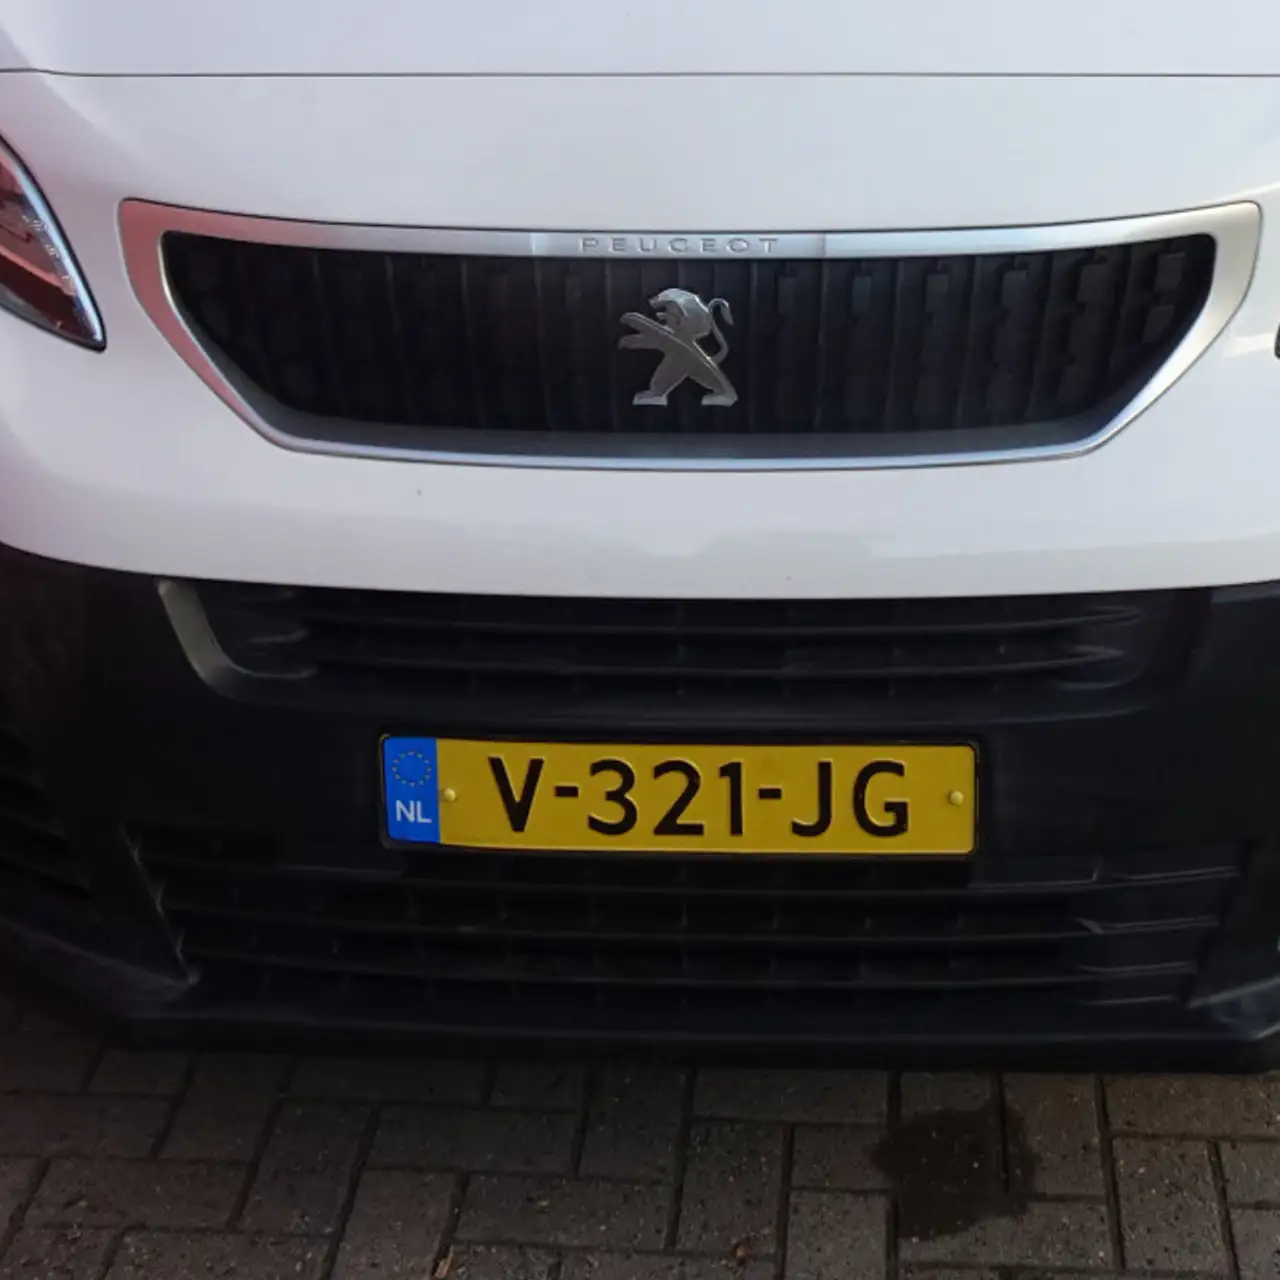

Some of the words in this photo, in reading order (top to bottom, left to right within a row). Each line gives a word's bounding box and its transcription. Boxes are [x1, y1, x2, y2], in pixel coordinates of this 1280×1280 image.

[578, 237, 779, 254] PEUGEOT
[487, 756, 911, 838] V-321-JG
[396, 799, 433, 824] NL
